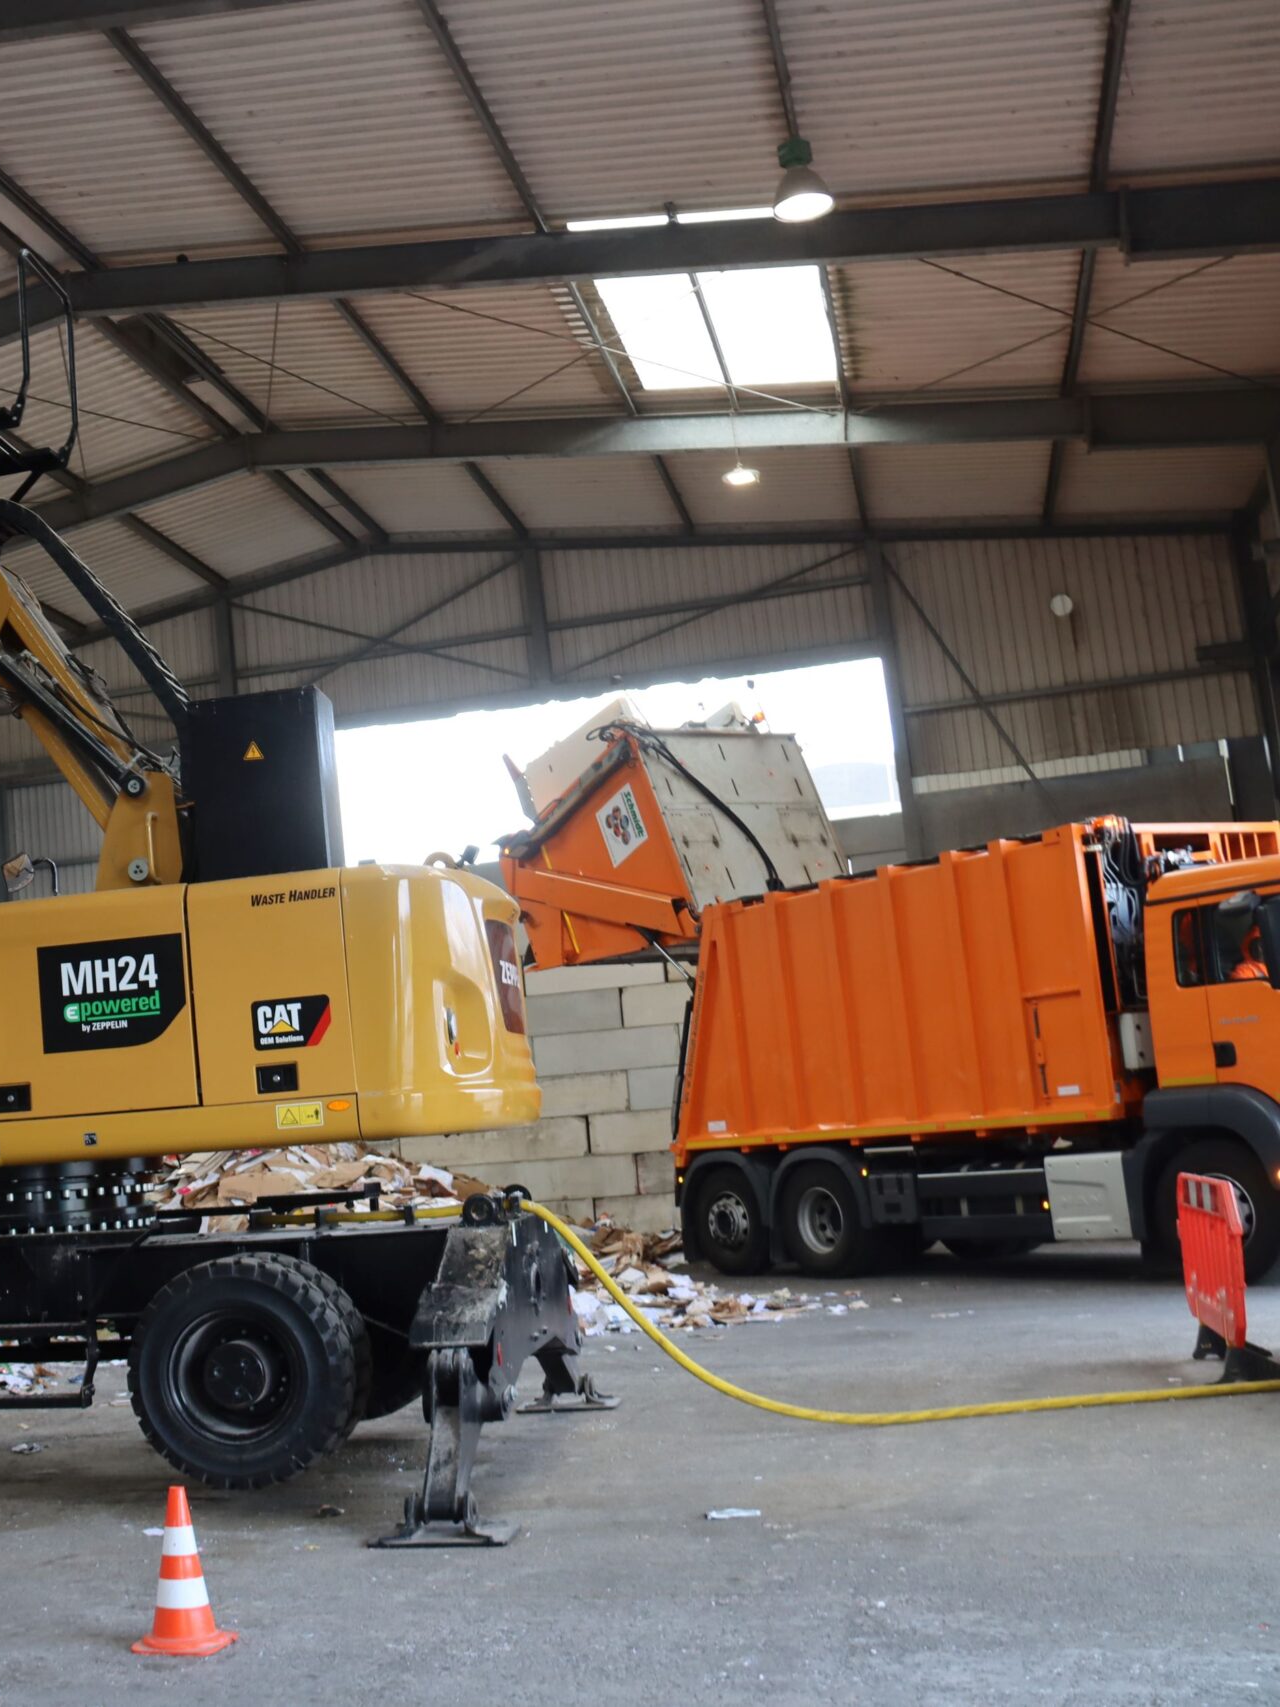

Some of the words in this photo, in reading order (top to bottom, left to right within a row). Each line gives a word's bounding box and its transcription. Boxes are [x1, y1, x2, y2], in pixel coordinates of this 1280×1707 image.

[623, 791, 645, 838] Schmidt
[250, 893, 286, 907] WASTE
[288, 887, 336, 903] HANDLER
[60, 953, 159, 997] MH24
[81, 1023, 91, 1033] by
[91, 1019, 128, 1031] ZEPPELIN
[256, 1002, 302, 1035] CAT
[260, 1036, 274, 1045] OEM
